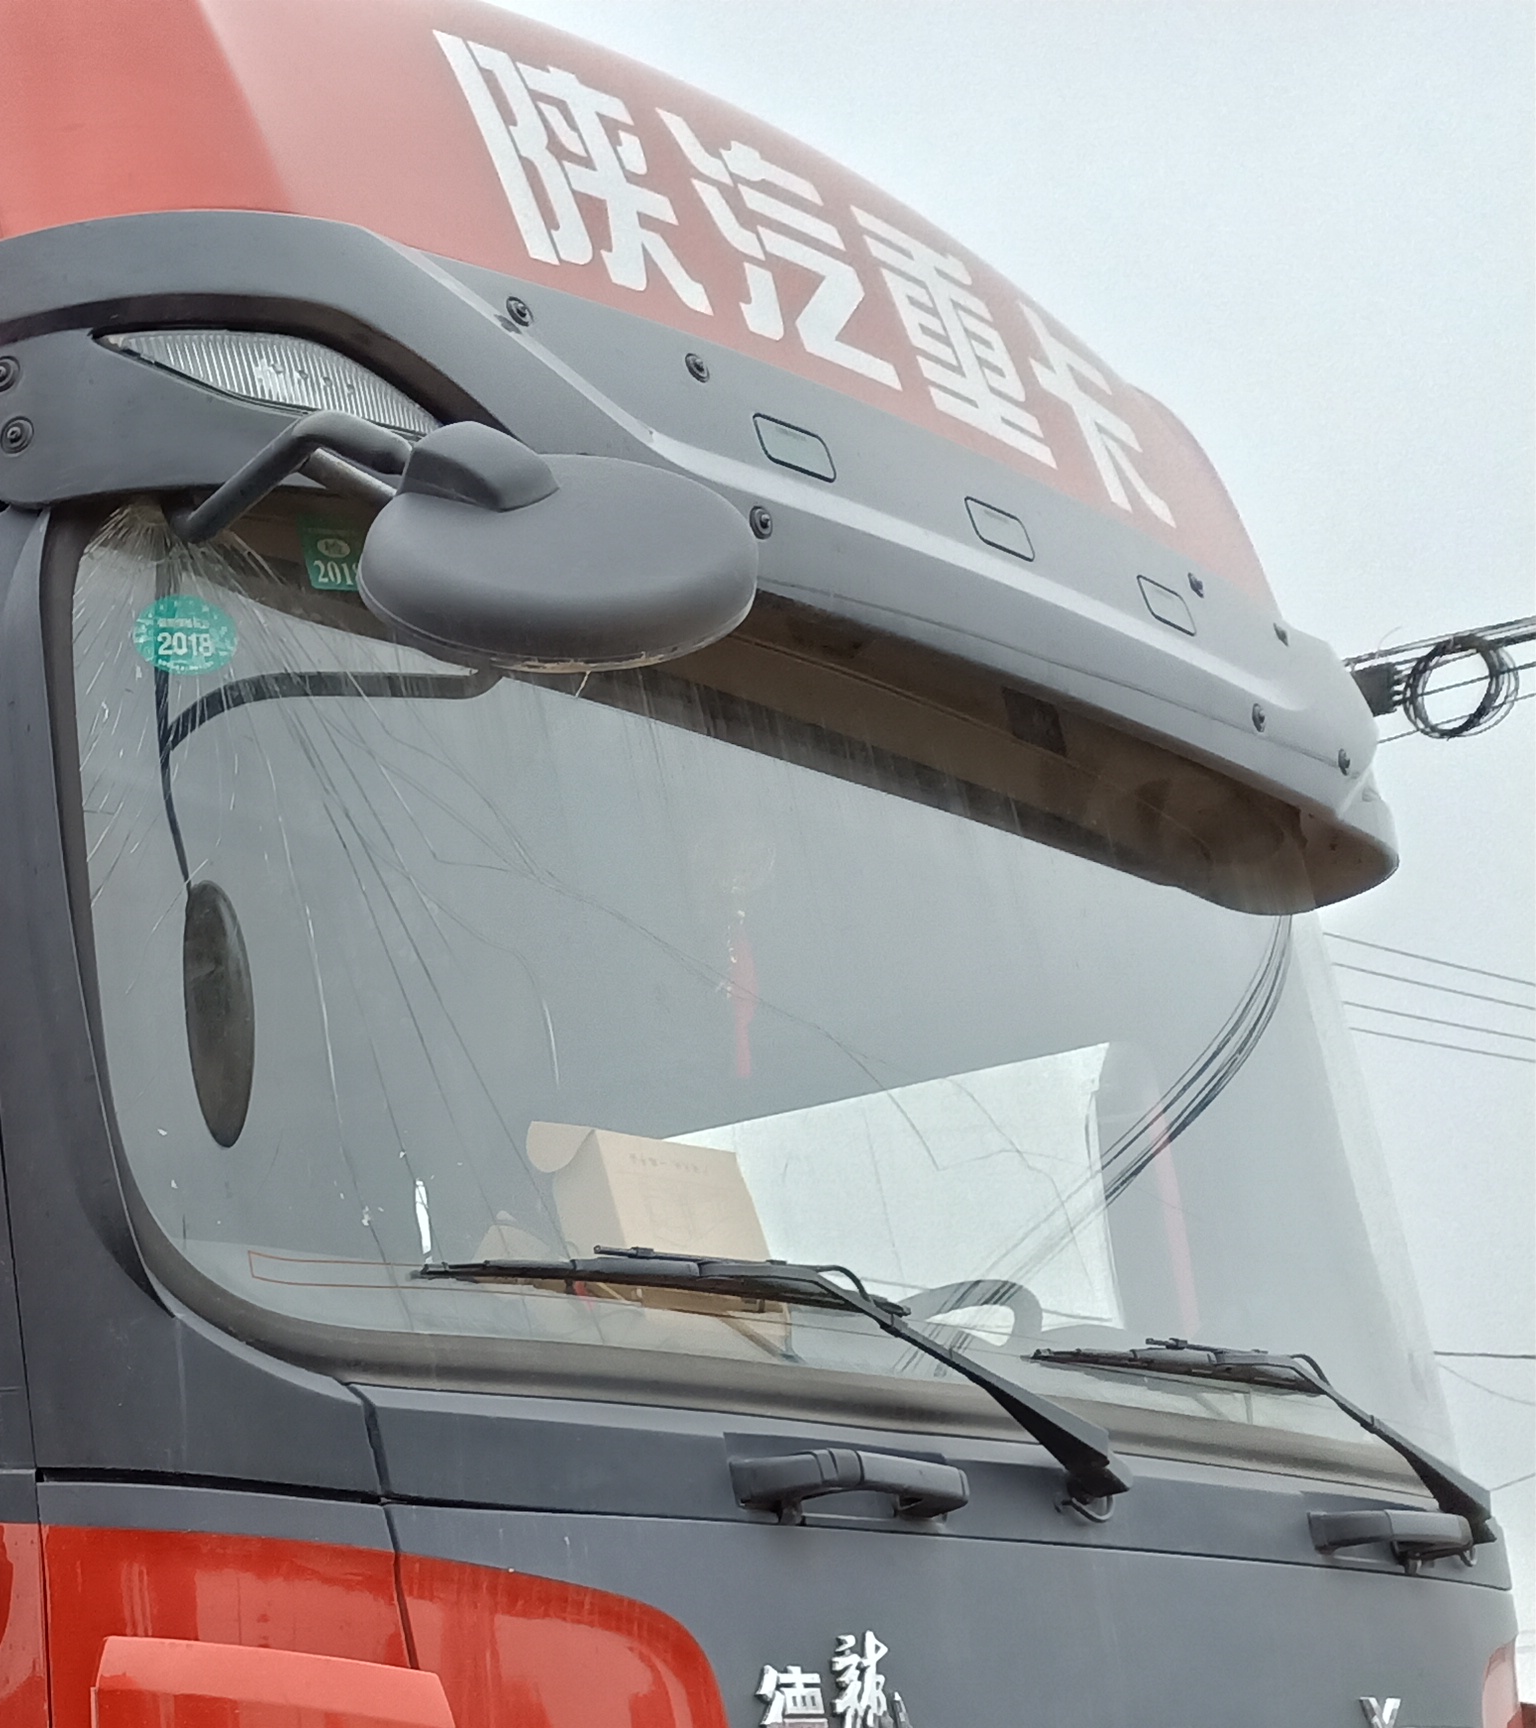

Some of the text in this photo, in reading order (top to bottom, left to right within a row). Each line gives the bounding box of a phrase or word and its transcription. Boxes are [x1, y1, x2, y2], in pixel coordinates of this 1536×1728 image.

[432, 29, 1177, 528] 陕汽重卡
[313, 560, 360, 586] 201
[157, 631, 215, 656] 2018
